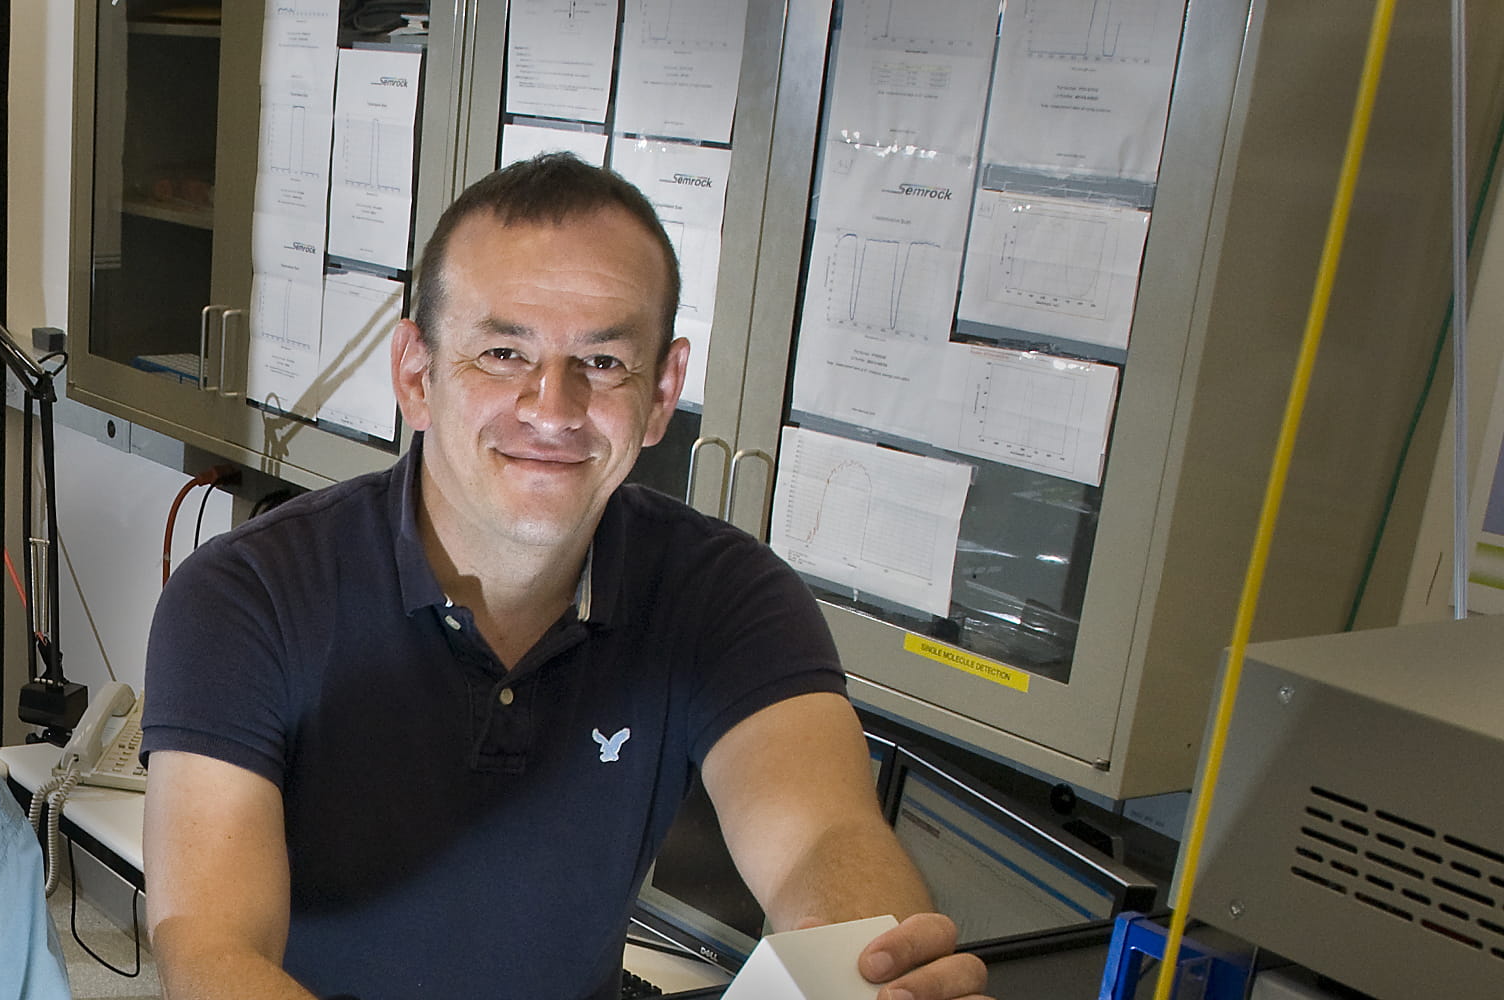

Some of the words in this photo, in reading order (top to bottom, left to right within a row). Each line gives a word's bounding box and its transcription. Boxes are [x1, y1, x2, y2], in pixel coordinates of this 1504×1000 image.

[380, 76, 409, 88] Semrock
[672, 173, 712, 188] Semrock
[898, 184, 952, 201] Semrock
[293, 242, 316, 255] Semrock
[920, 643, 941, 657] SINGLE
[943, 651, 975, 669] MOLECULE
[976, 662, 1011, 681] DETECTION
[700, 946, 719, 963] DELL
